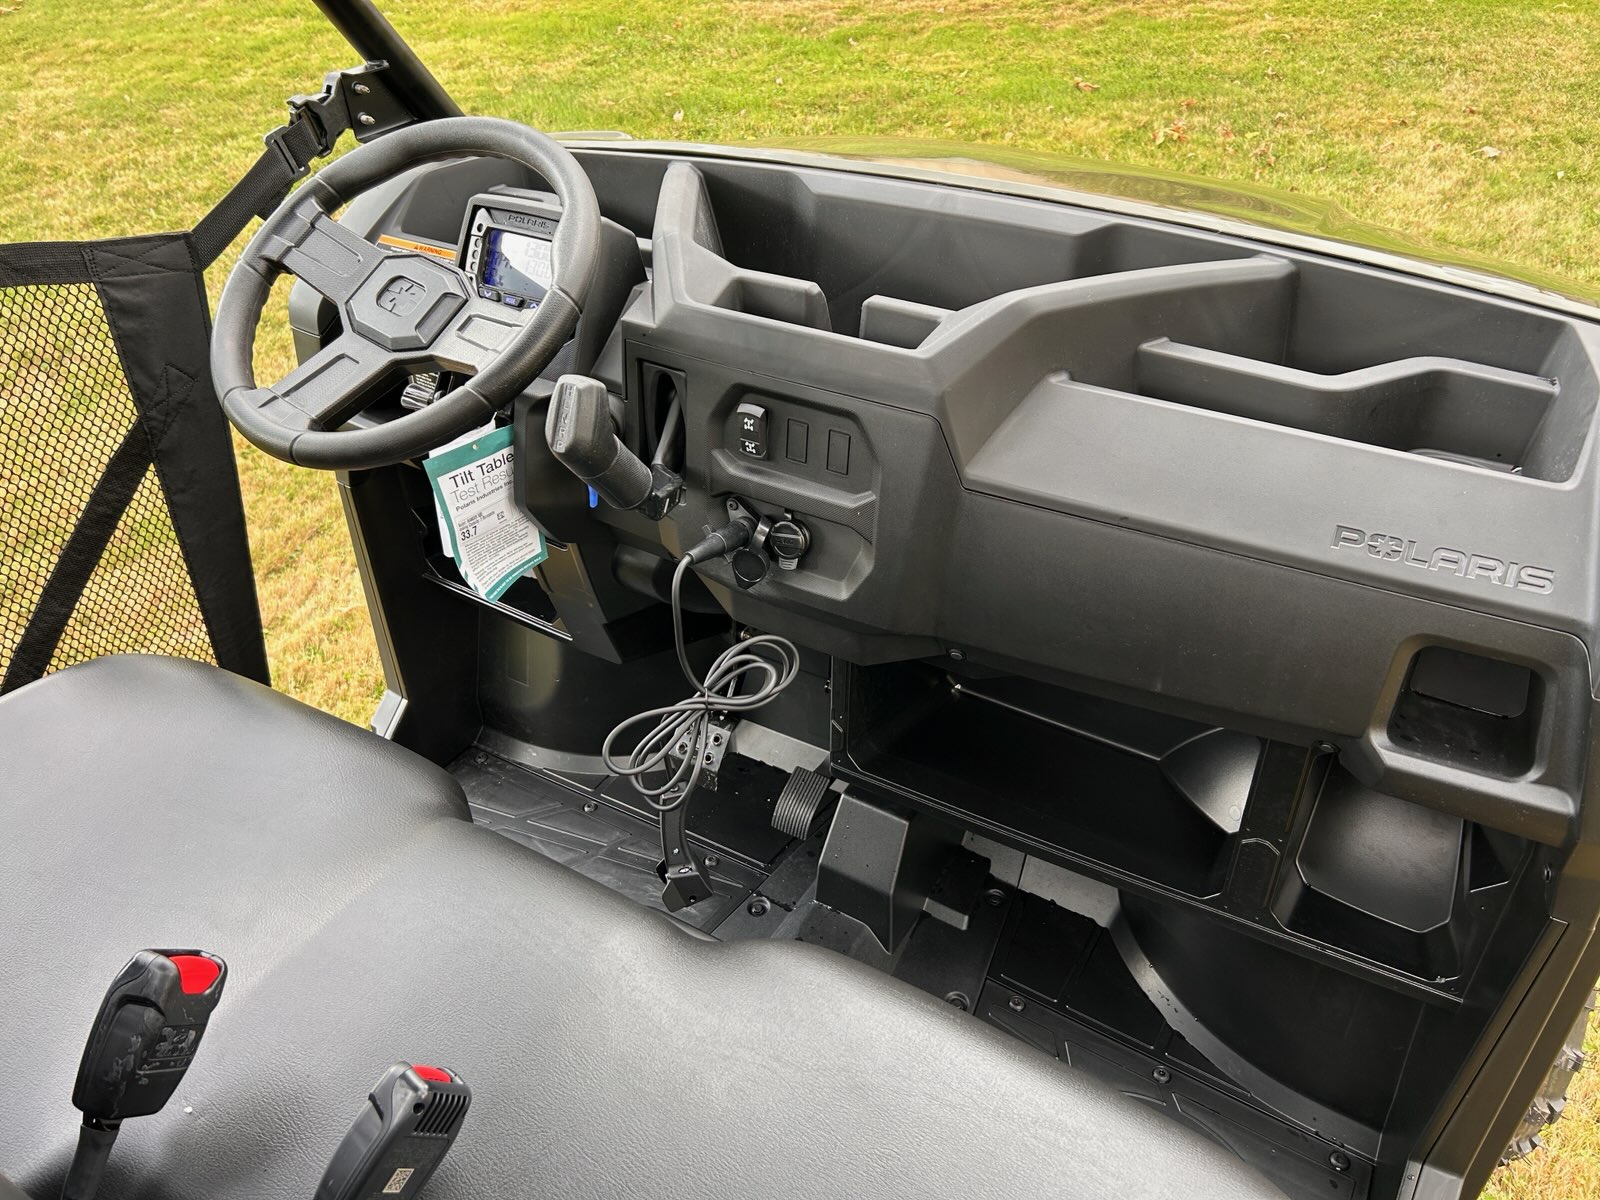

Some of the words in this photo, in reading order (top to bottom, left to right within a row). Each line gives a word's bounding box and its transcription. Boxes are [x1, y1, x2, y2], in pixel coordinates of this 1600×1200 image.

[507, 214, 550, 230] POLARIS
[419, 245, 443, 256] WARNING
[449, 469, 475, 488] Tilt
[476, 453, 514, 476] Table
[450, 483, 480, 503] Test
[482, 467, 514, 490] Resu
[455, 499, 476, 512] Polaris
[476, 485, 503, 501] Industries
[461, 525, 477, 541] 33.7
[1330, 524, 1556, 595] POLARIS
